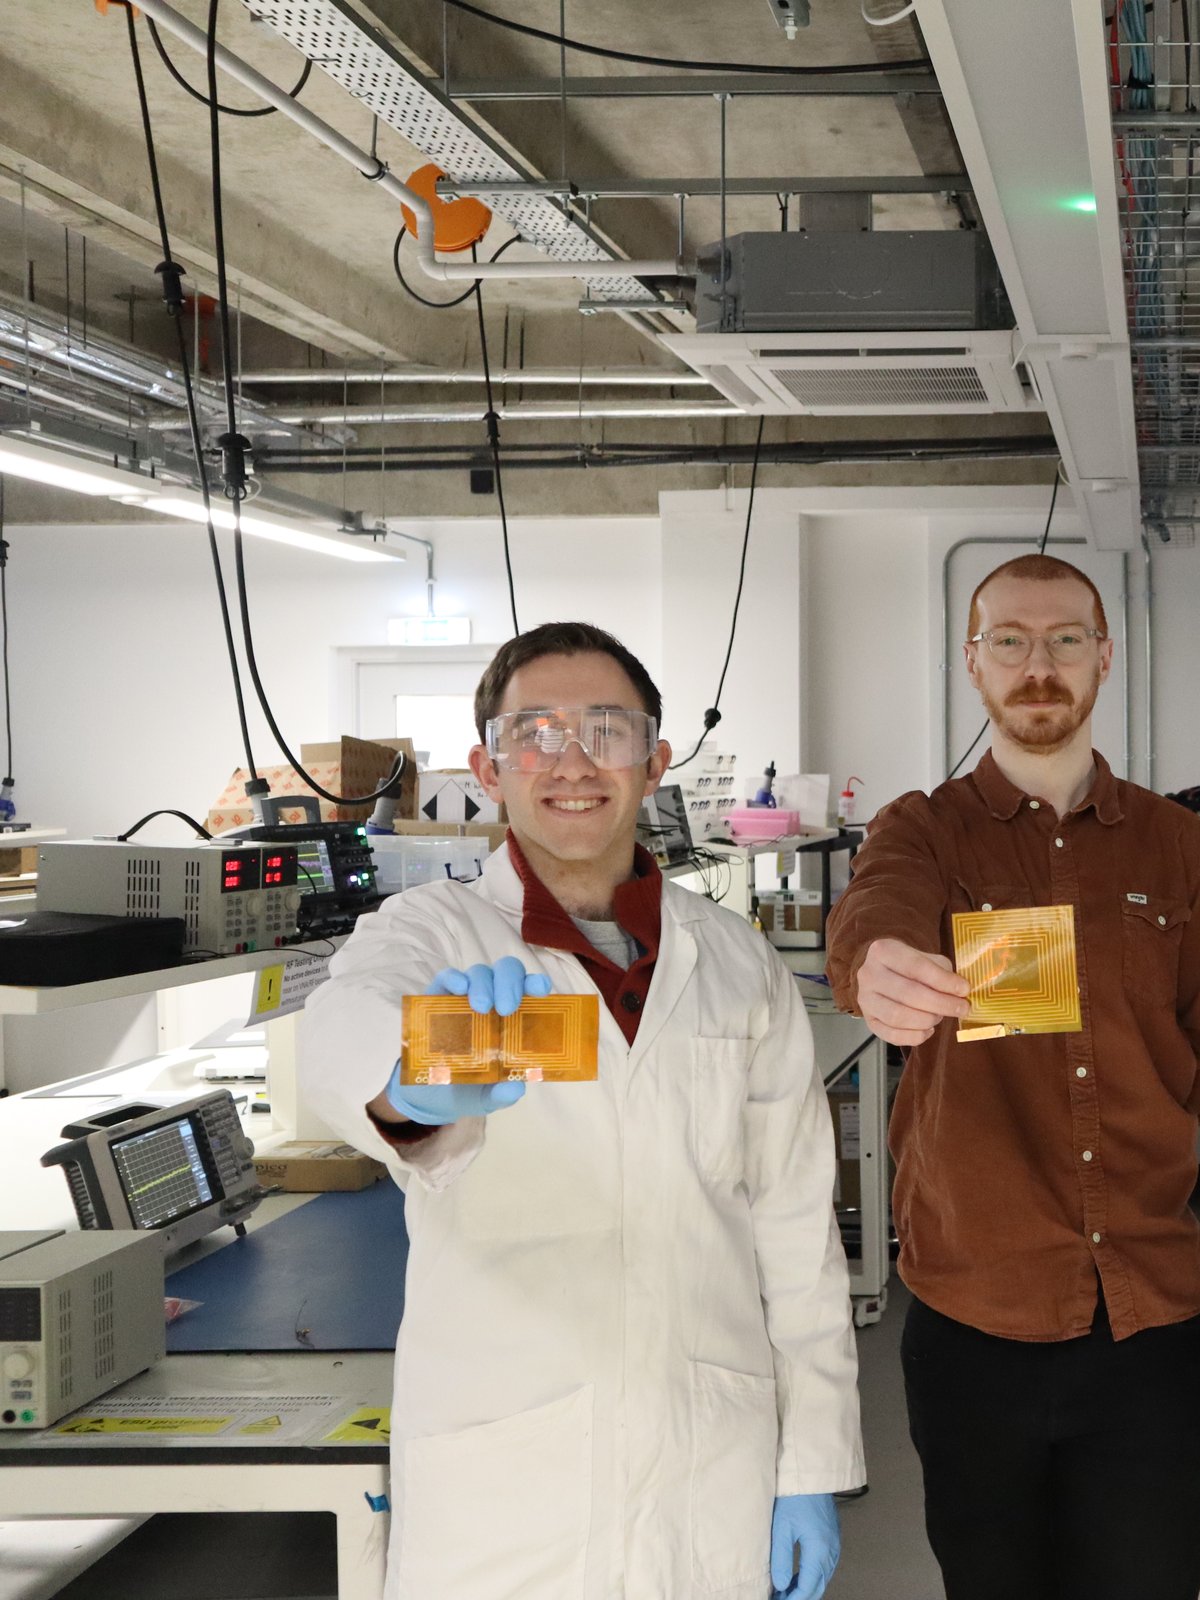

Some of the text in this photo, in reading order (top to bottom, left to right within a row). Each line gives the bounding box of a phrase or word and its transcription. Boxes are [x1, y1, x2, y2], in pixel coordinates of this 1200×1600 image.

[285, 959, 295, 970] RF
[294, 956, 313, 968] Testing
[291, 971, 304, 981] active
[255, 1163, 288, 1172] pico
